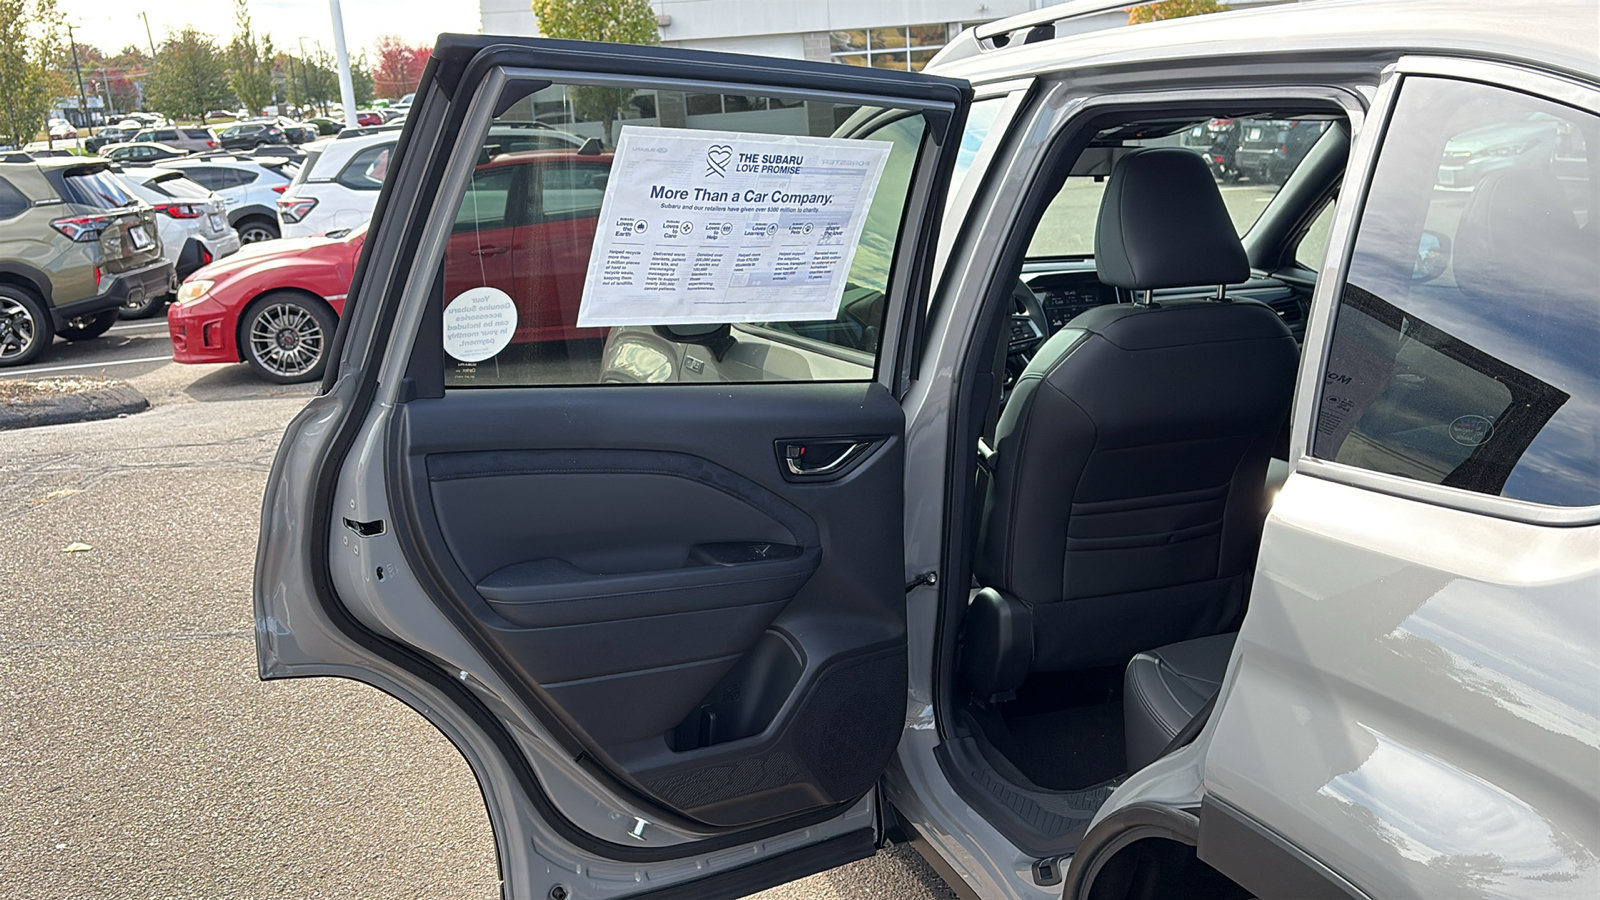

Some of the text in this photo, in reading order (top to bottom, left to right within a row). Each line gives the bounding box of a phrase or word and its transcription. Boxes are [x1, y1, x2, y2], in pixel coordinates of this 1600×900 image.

[738, 153, 804, 165] THE SUBARU
[736, 164, 802, 174] LOVE PROMISE
[650, 185, 688, 200] More
[694, 188, 728, 202] Than
[732, 192, 740, 202] a
[744, 190, 768, 202] Car
